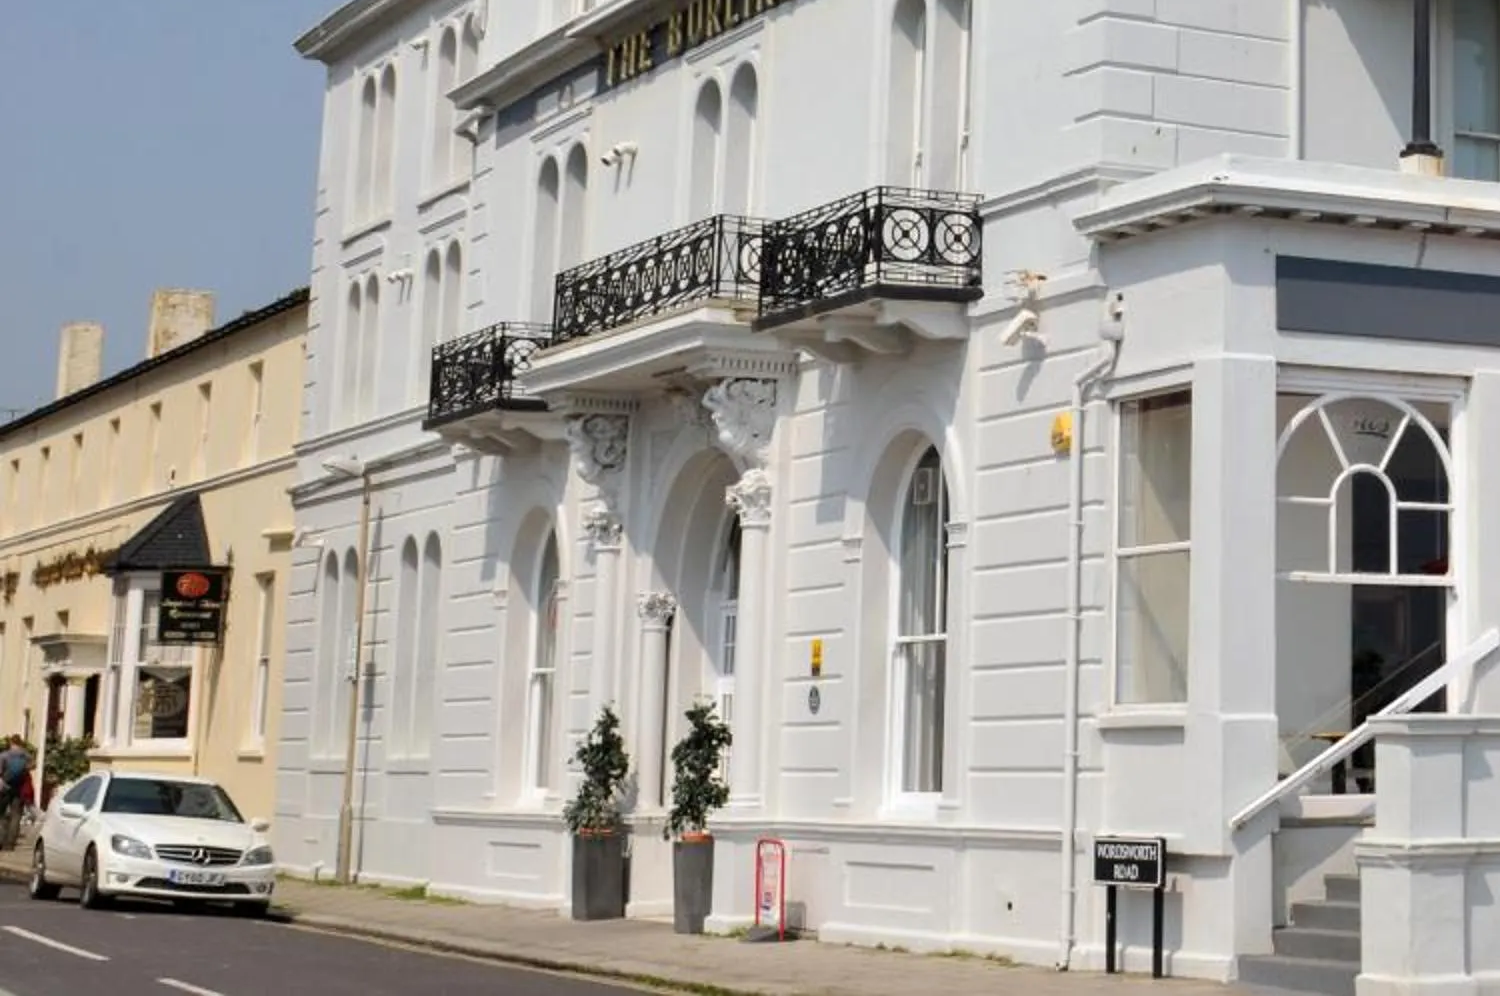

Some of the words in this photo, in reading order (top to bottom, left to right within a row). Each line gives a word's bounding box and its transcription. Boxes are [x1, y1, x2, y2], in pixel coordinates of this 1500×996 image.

[604, 30, 653, 86] THE
[1097, 844, 1157, 860] WORDSWORTH
[1113, 863, 1139, 880] ROAD
